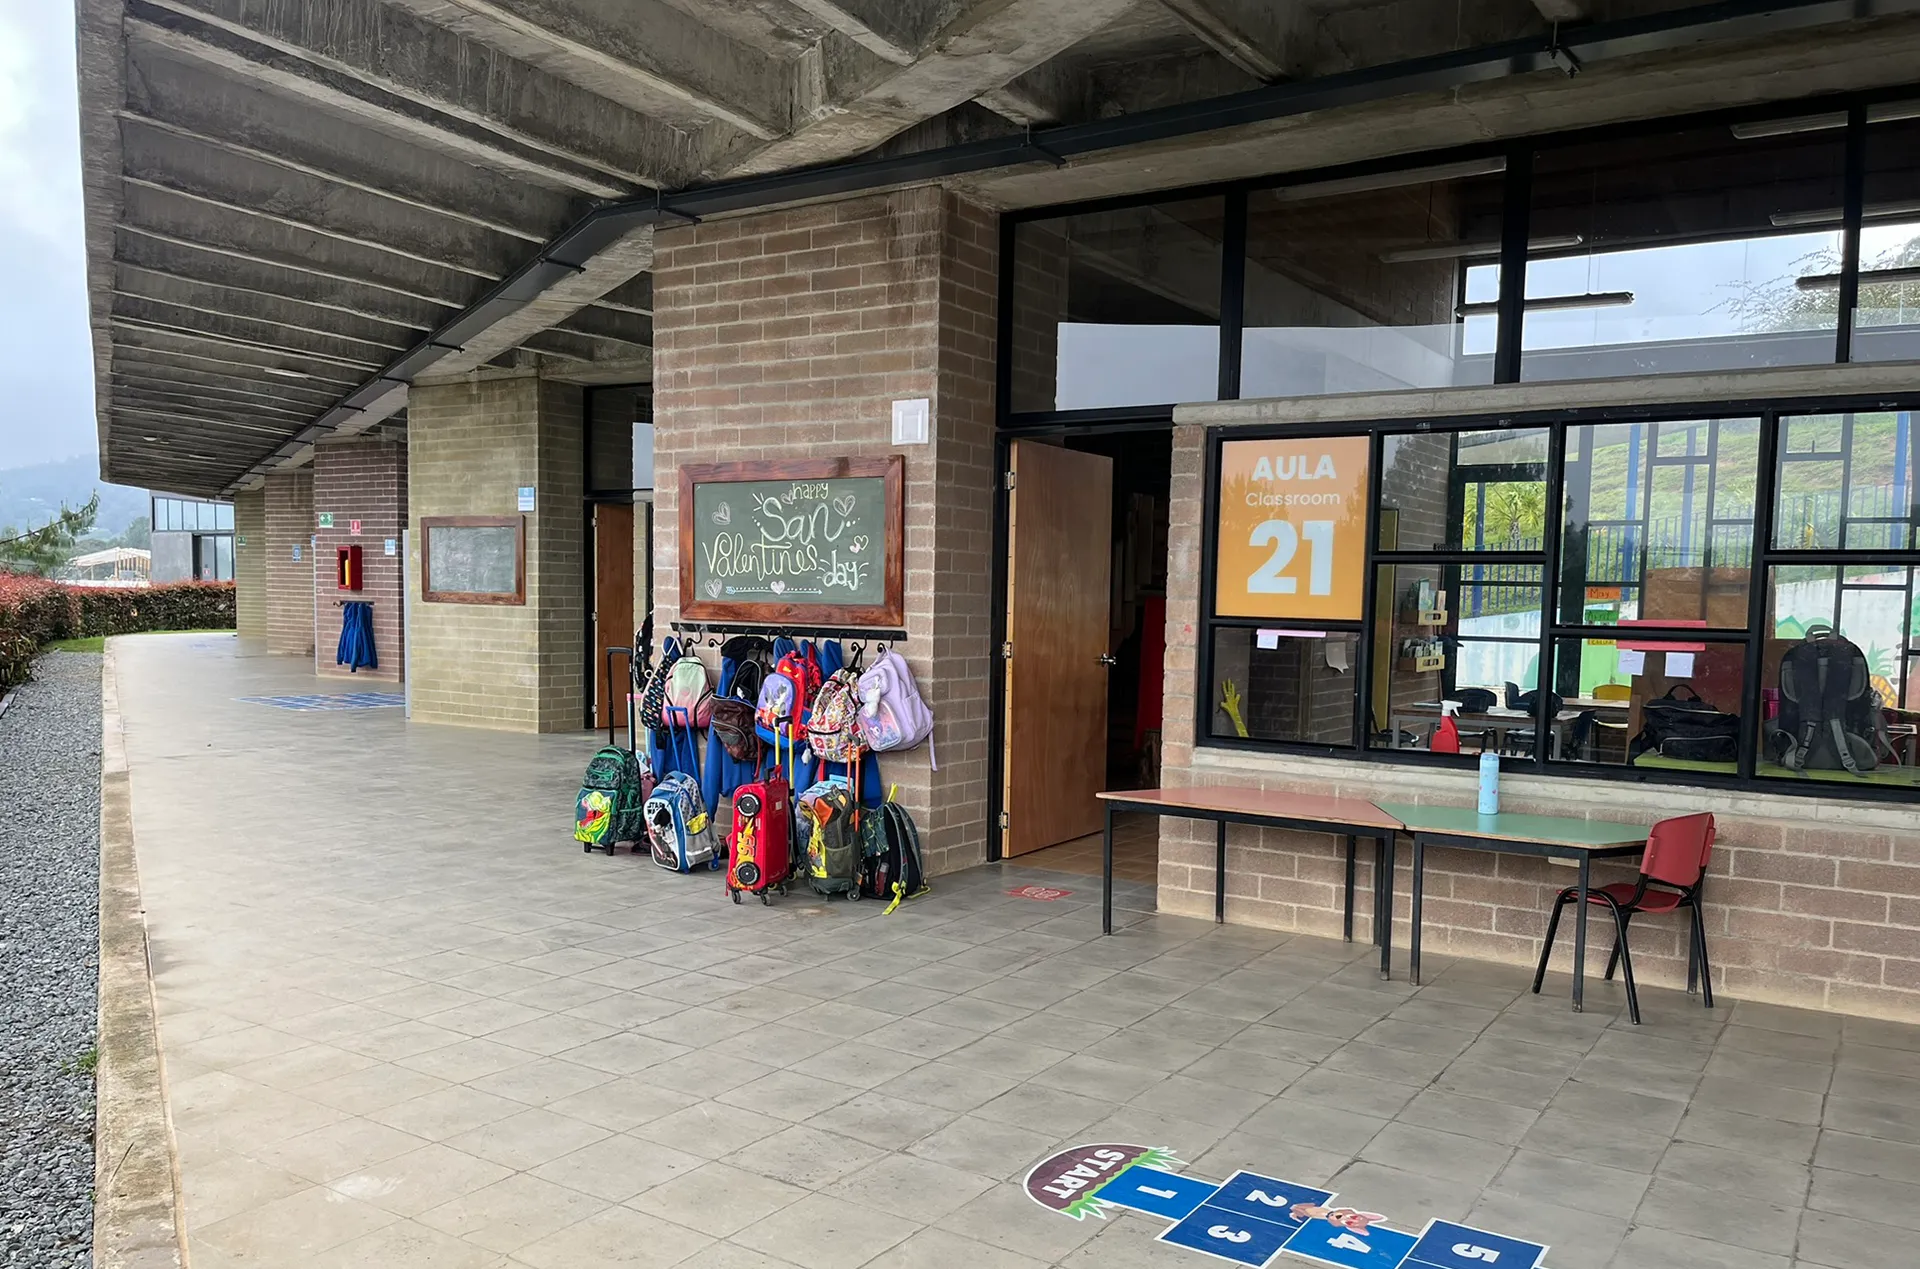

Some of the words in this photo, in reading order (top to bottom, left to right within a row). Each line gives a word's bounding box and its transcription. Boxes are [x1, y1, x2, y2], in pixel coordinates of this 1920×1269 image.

[1251, 454, 1337, 481] AULA
[792, 482, 829, 500] happy
[1245, 491, 1341, 507] Classroom
[760, 496, 845, 546] San
[1246, 519, 1335, 596] 21
[822, 549, 860, 591] day
[1590, 587, 1610, 599] May
[736, 832, 756, 858] 95
[1041, 1148, 1126, 1199] START
[1135, 1184, 1179, 1199] 1
[1244, 1189, 1288, 1207] 2
[1207, 1225, 1252, 1244] 3
[1326, 1232, 1372, 1254] 4
[1451, 1242, 1501, 1264] 5
